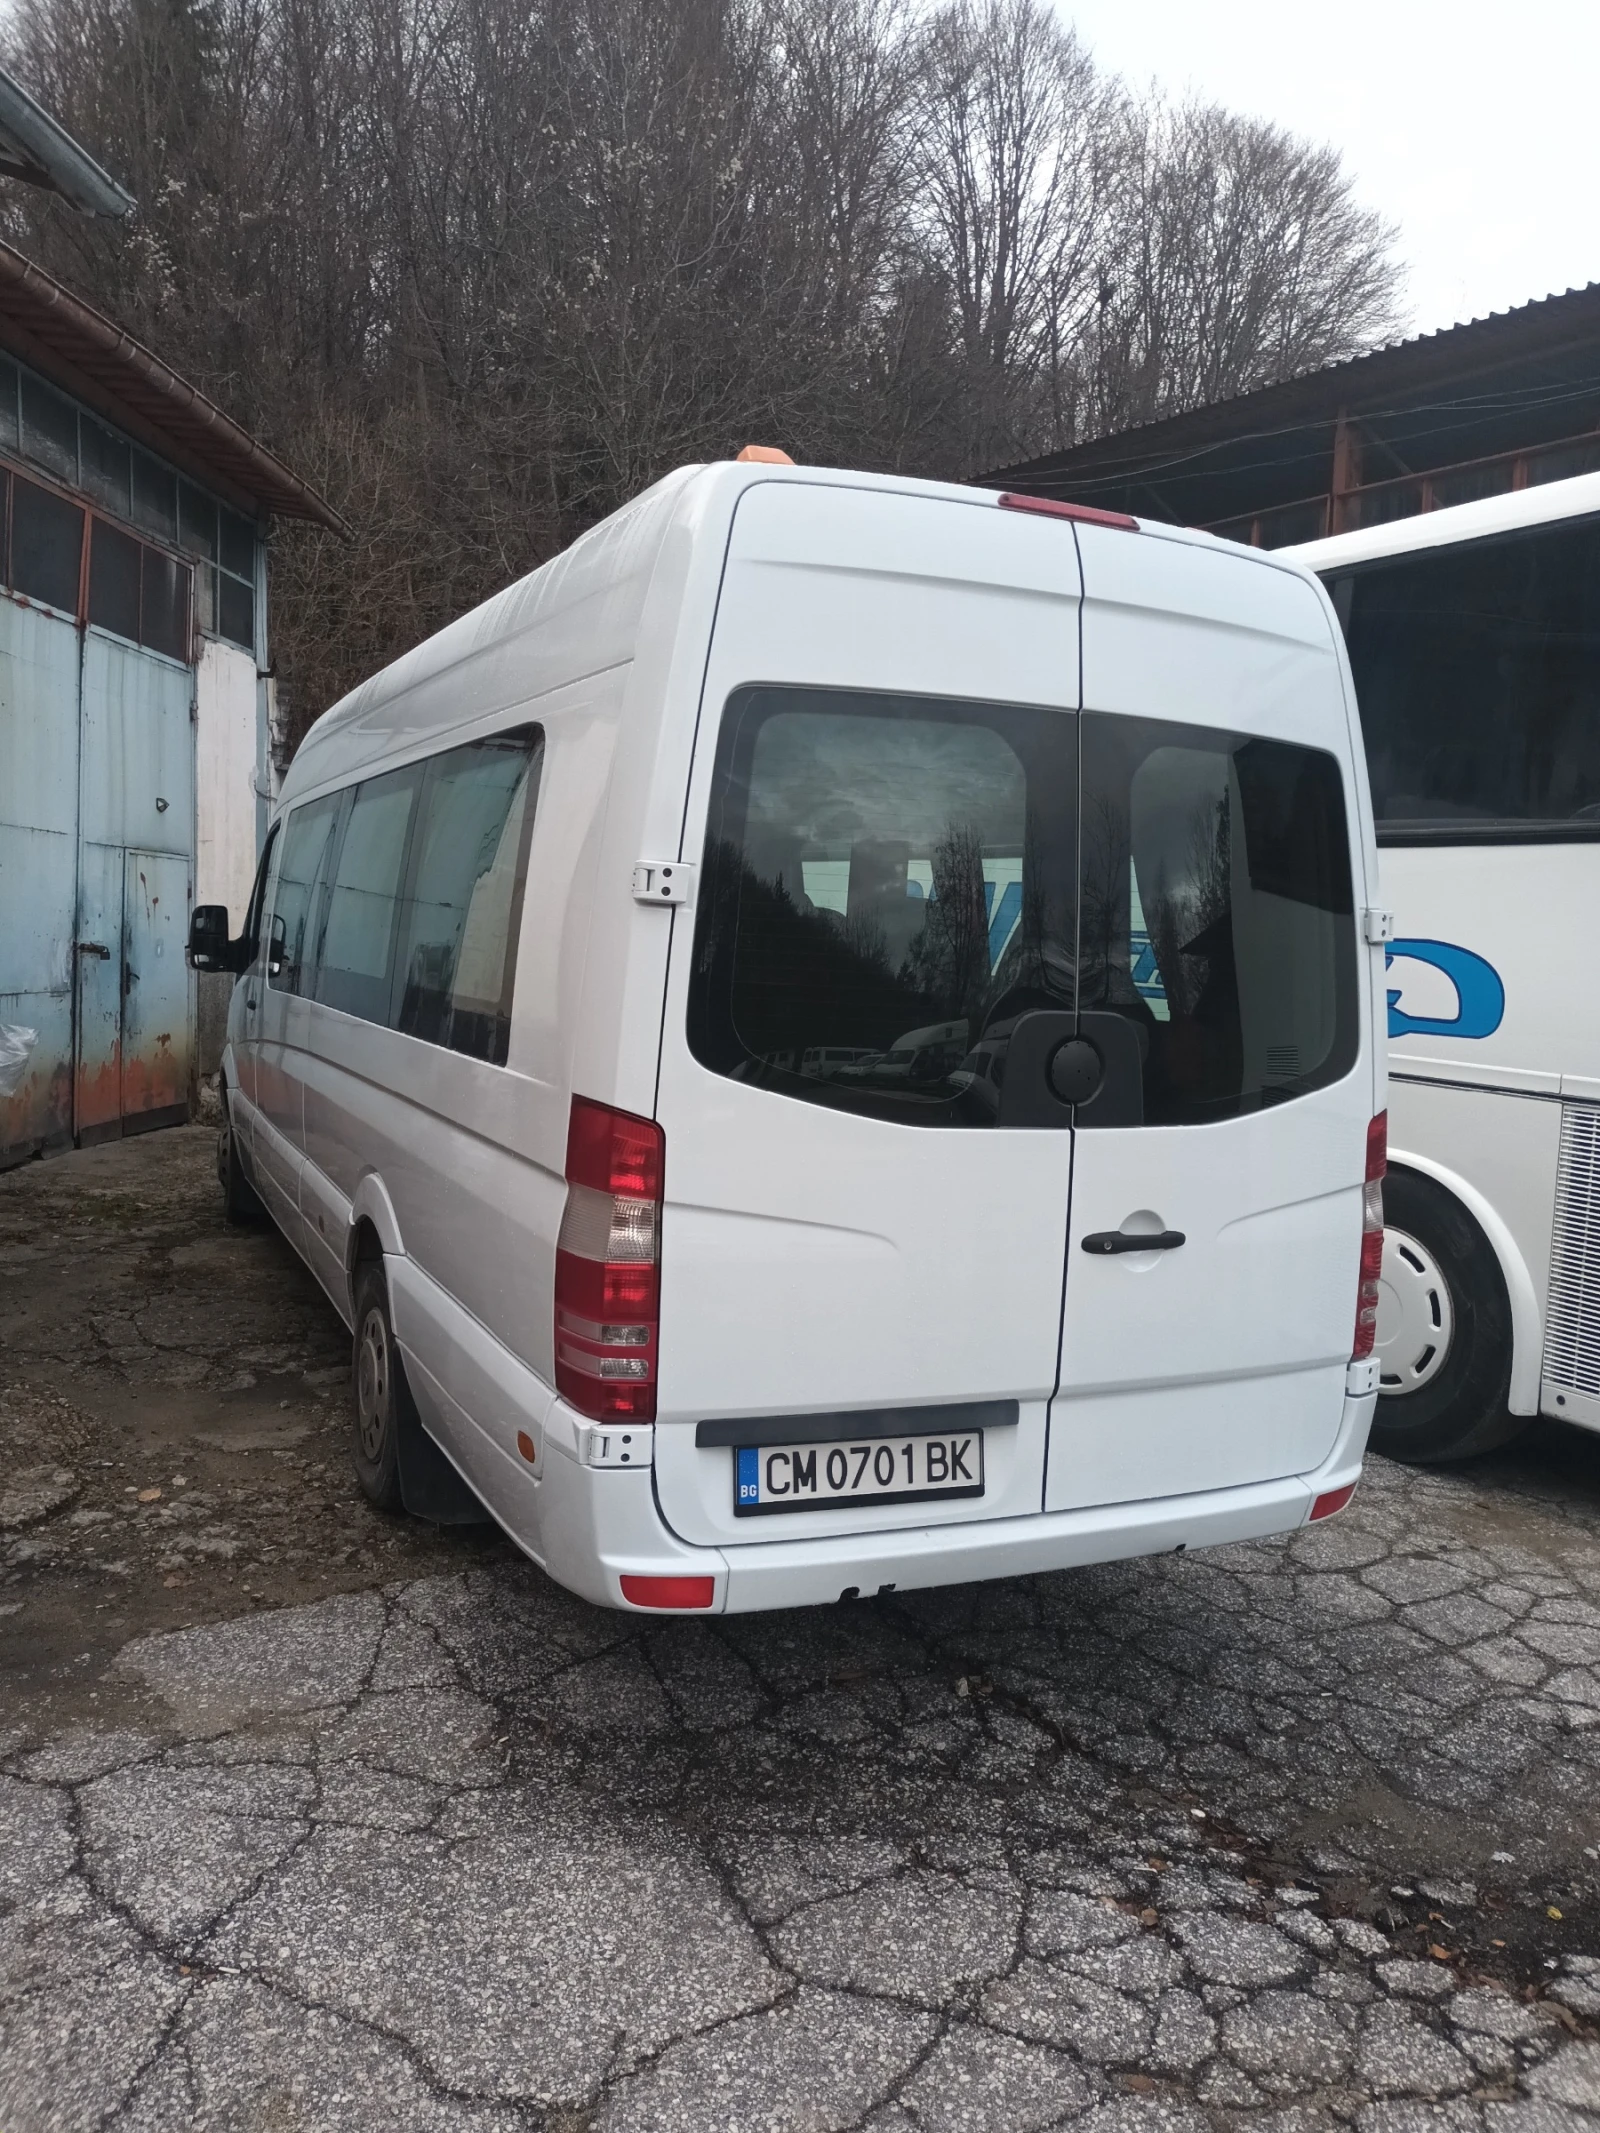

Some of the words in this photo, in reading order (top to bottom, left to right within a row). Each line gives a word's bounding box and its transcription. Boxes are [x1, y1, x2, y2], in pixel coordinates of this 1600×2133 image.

[766, 1450, 817, 1495] CM
[826, 1443, 913, 1490] 0701
[927, 1439, 973, 1481] BK
[739, 1484, 757, 1498] BG
